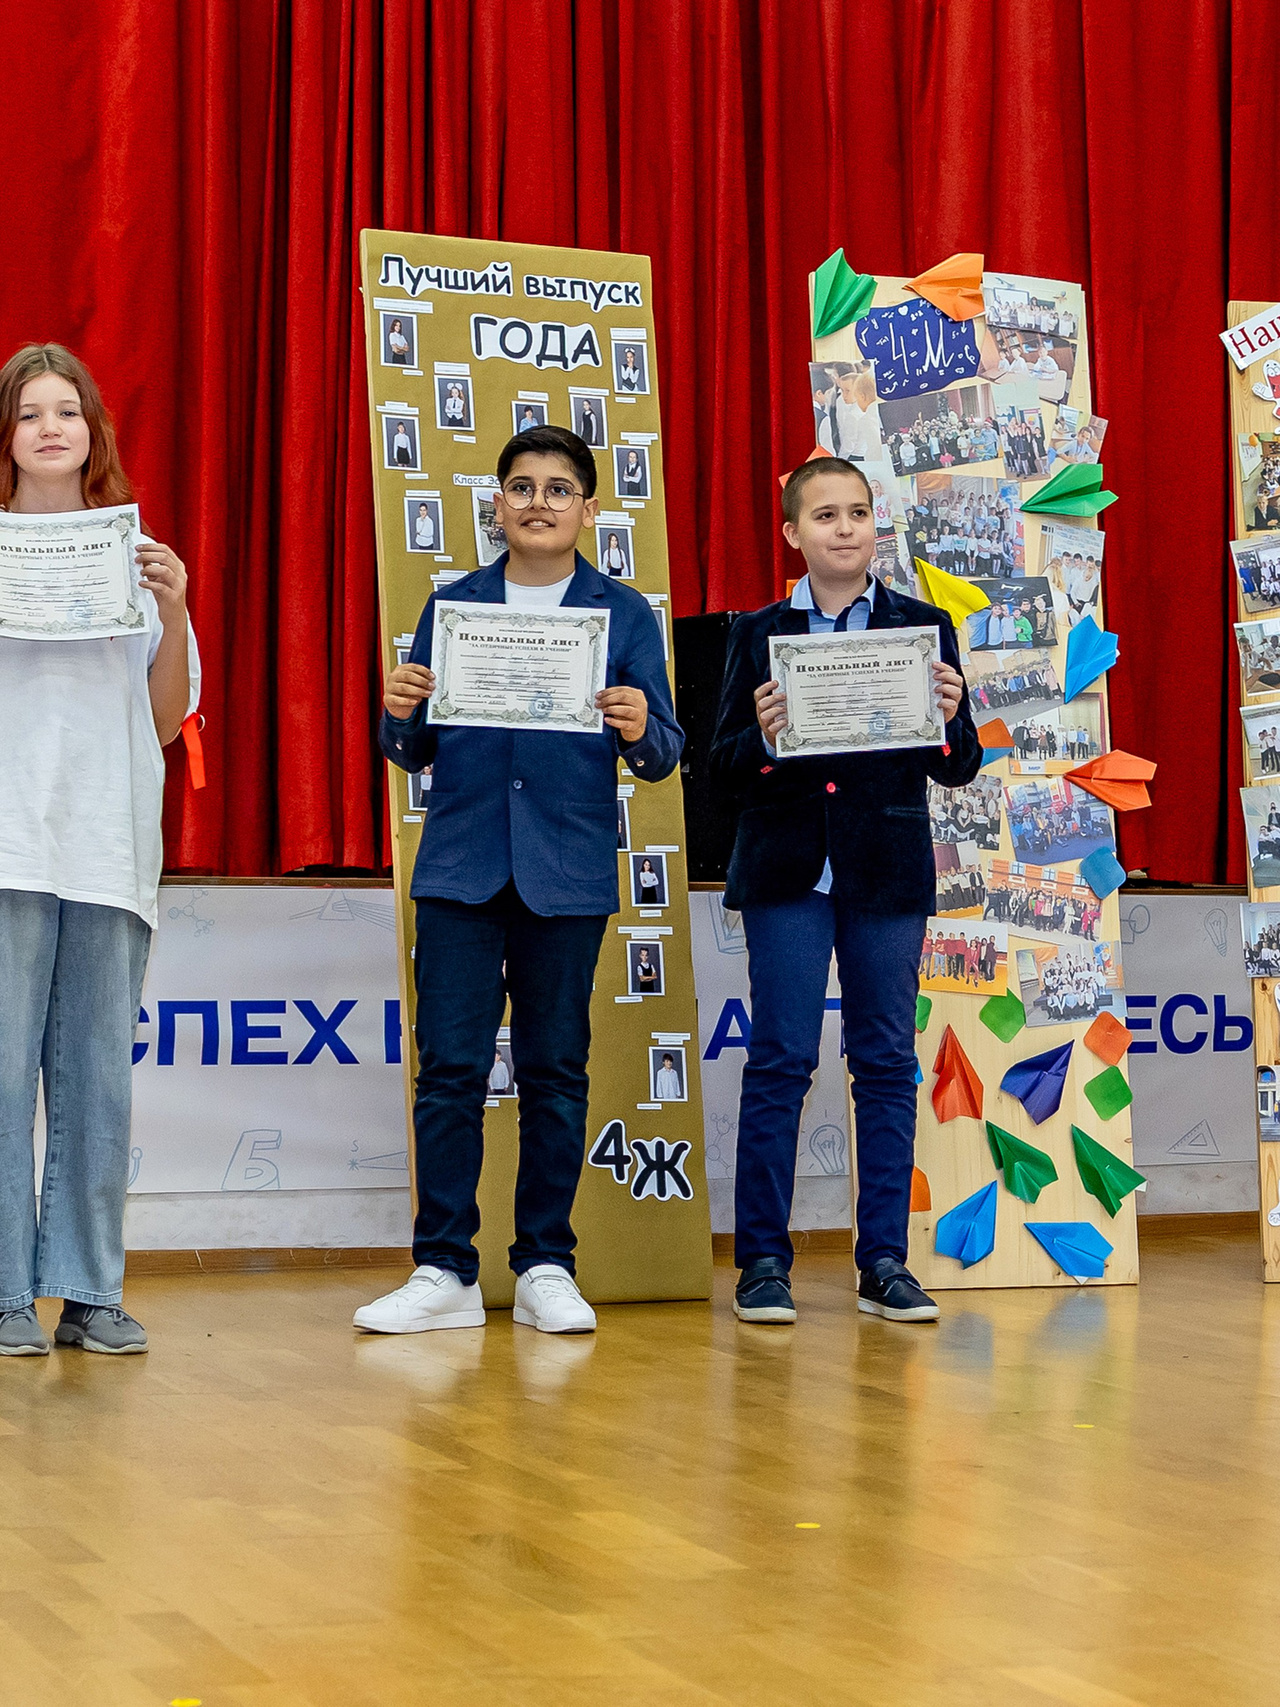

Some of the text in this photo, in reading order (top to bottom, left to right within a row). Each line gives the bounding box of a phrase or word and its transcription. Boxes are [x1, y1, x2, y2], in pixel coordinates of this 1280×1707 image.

[380, 256, 641, 311] Лучший выпуск
[474, 316, 600, 370] ГОДА
[1228, 315, 1280, 359] На
[454, 474, 484, 485] Класс
[1125, 993, 1254, 1055] ЕСЬ
[591, 1121, 692, 1199] 4Ж
